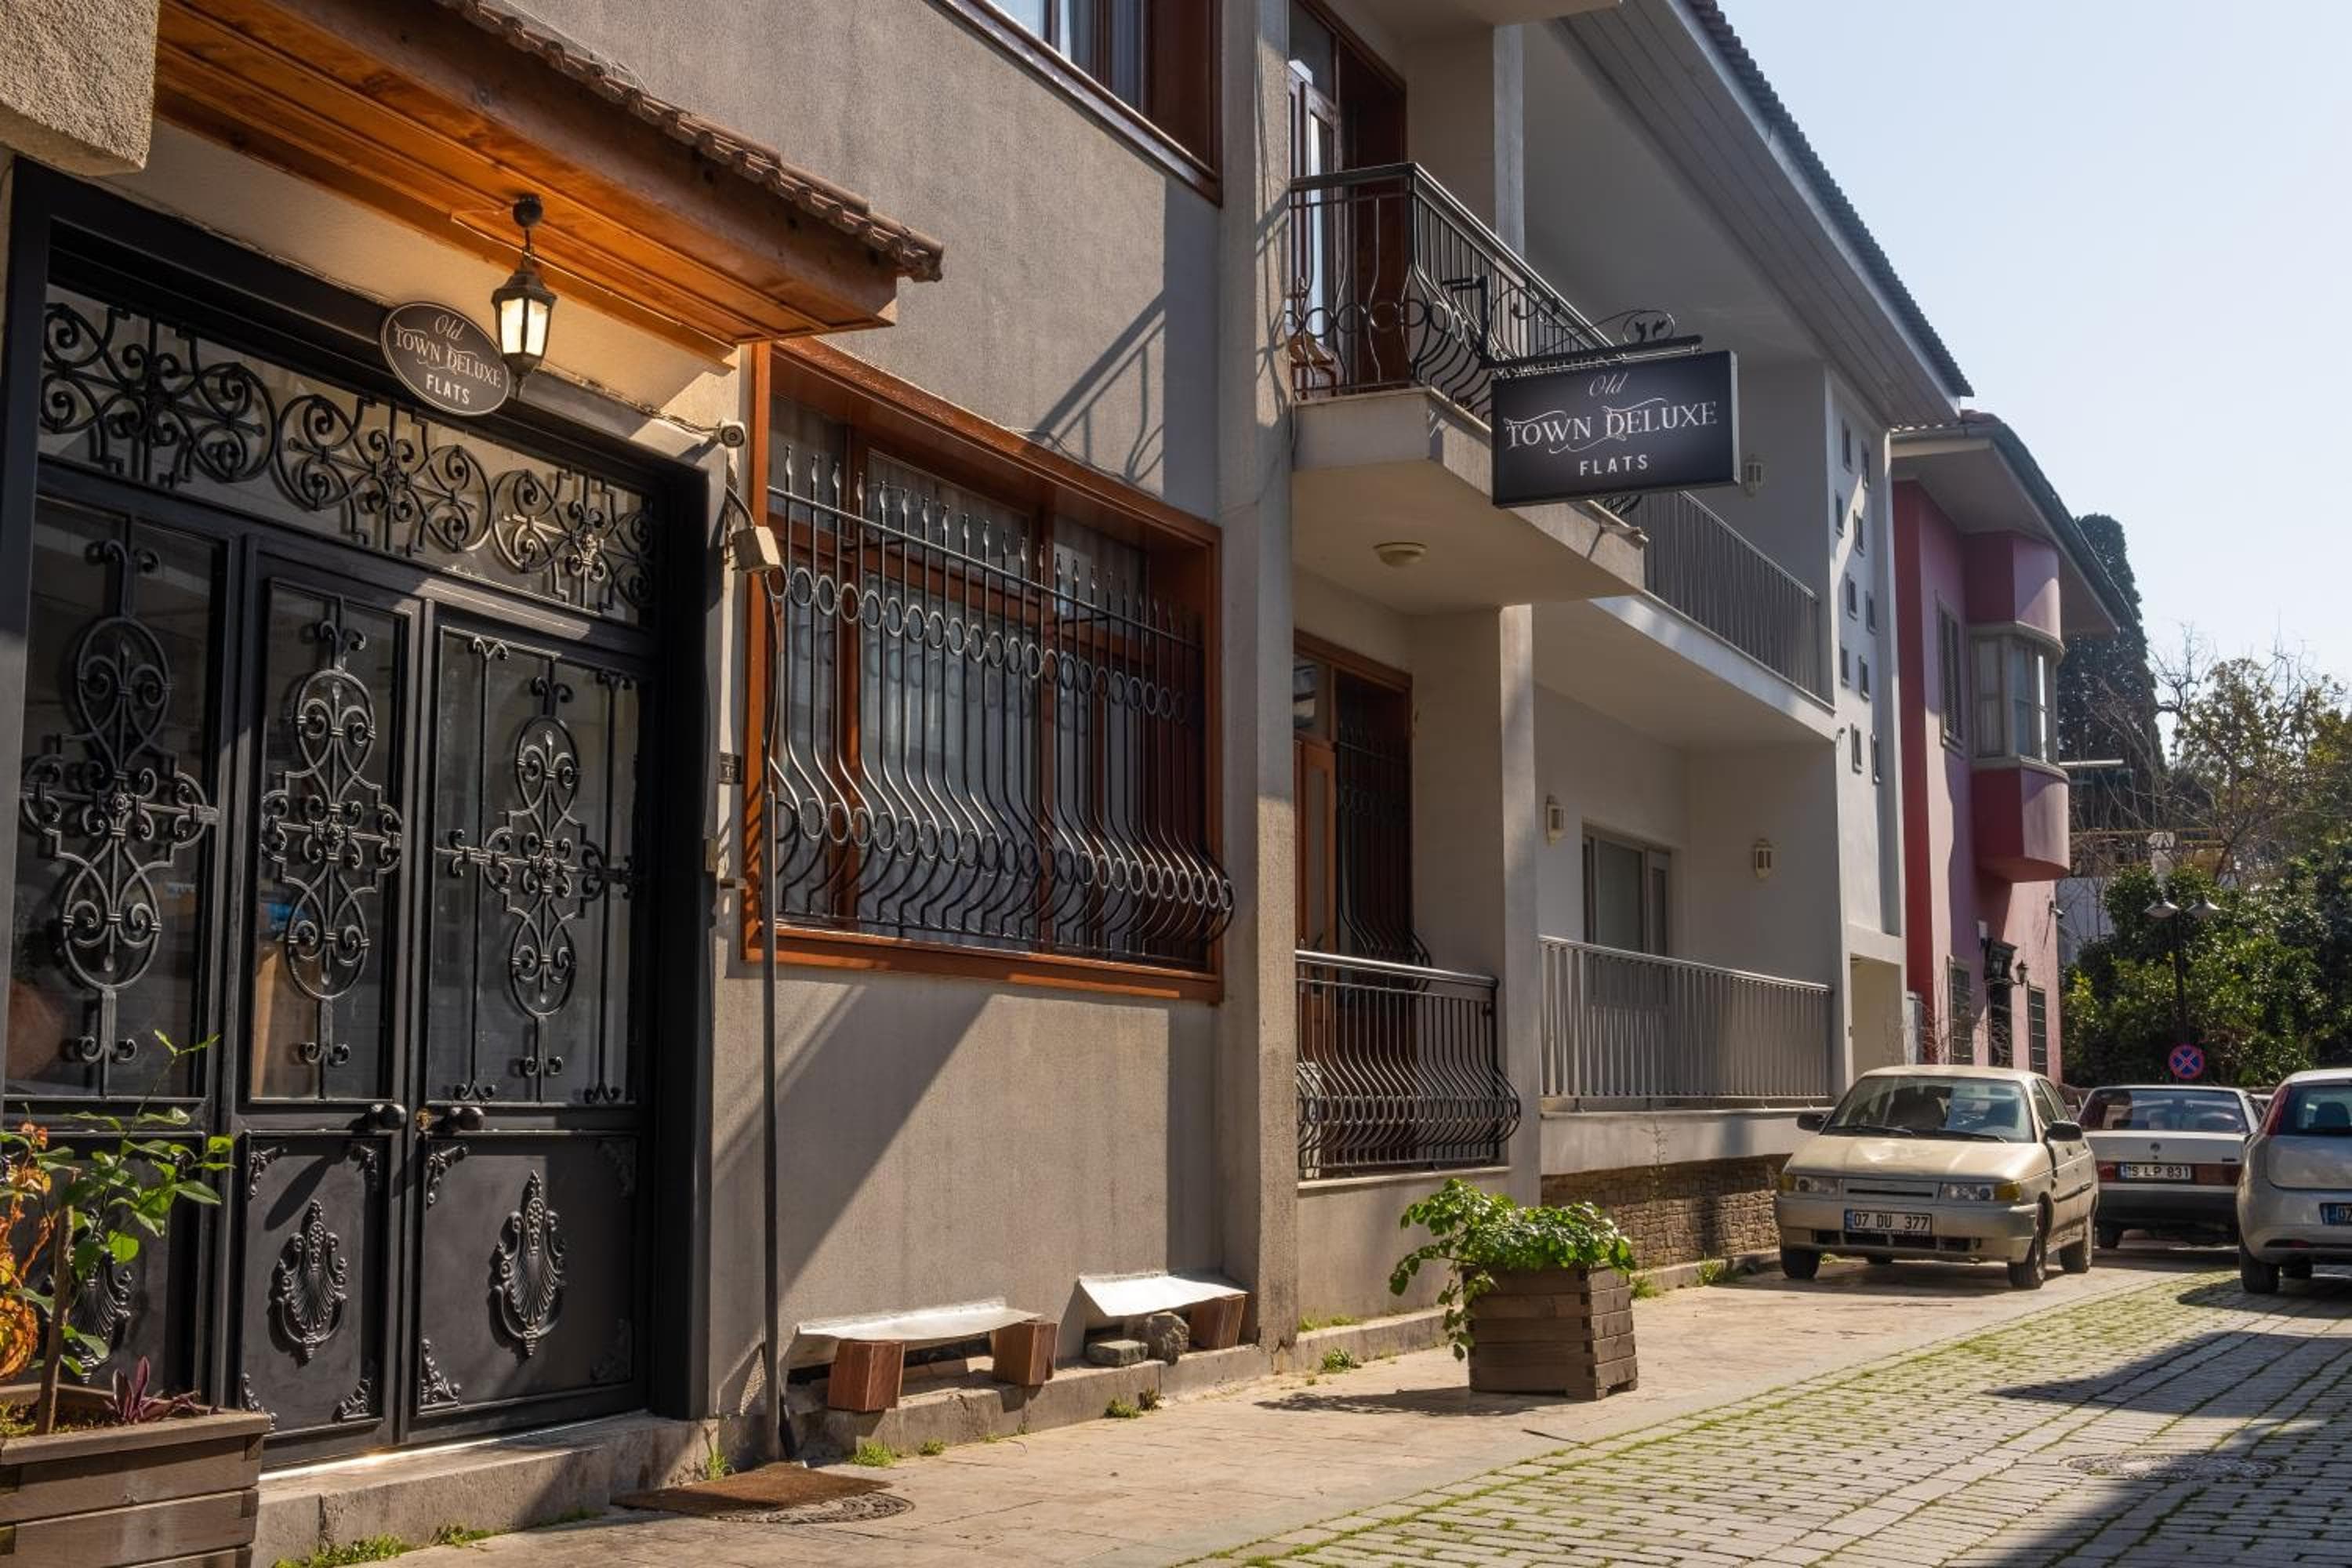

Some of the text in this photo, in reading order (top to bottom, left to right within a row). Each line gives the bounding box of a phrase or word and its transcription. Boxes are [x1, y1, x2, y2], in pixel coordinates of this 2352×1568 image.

[434, 314, 463, 341] Old
[394, 327, 502, 389] TOWN DELUXE
[426, 373, 470, 405] FLATS
[1589, 372, 1628, 396] Old
[1504, 400, 1718, 450] TOWN DELUXE
[1580, 454, 1649, 476] FLATS
[1855, 1213, 1929, 1230] 07 DU 377
